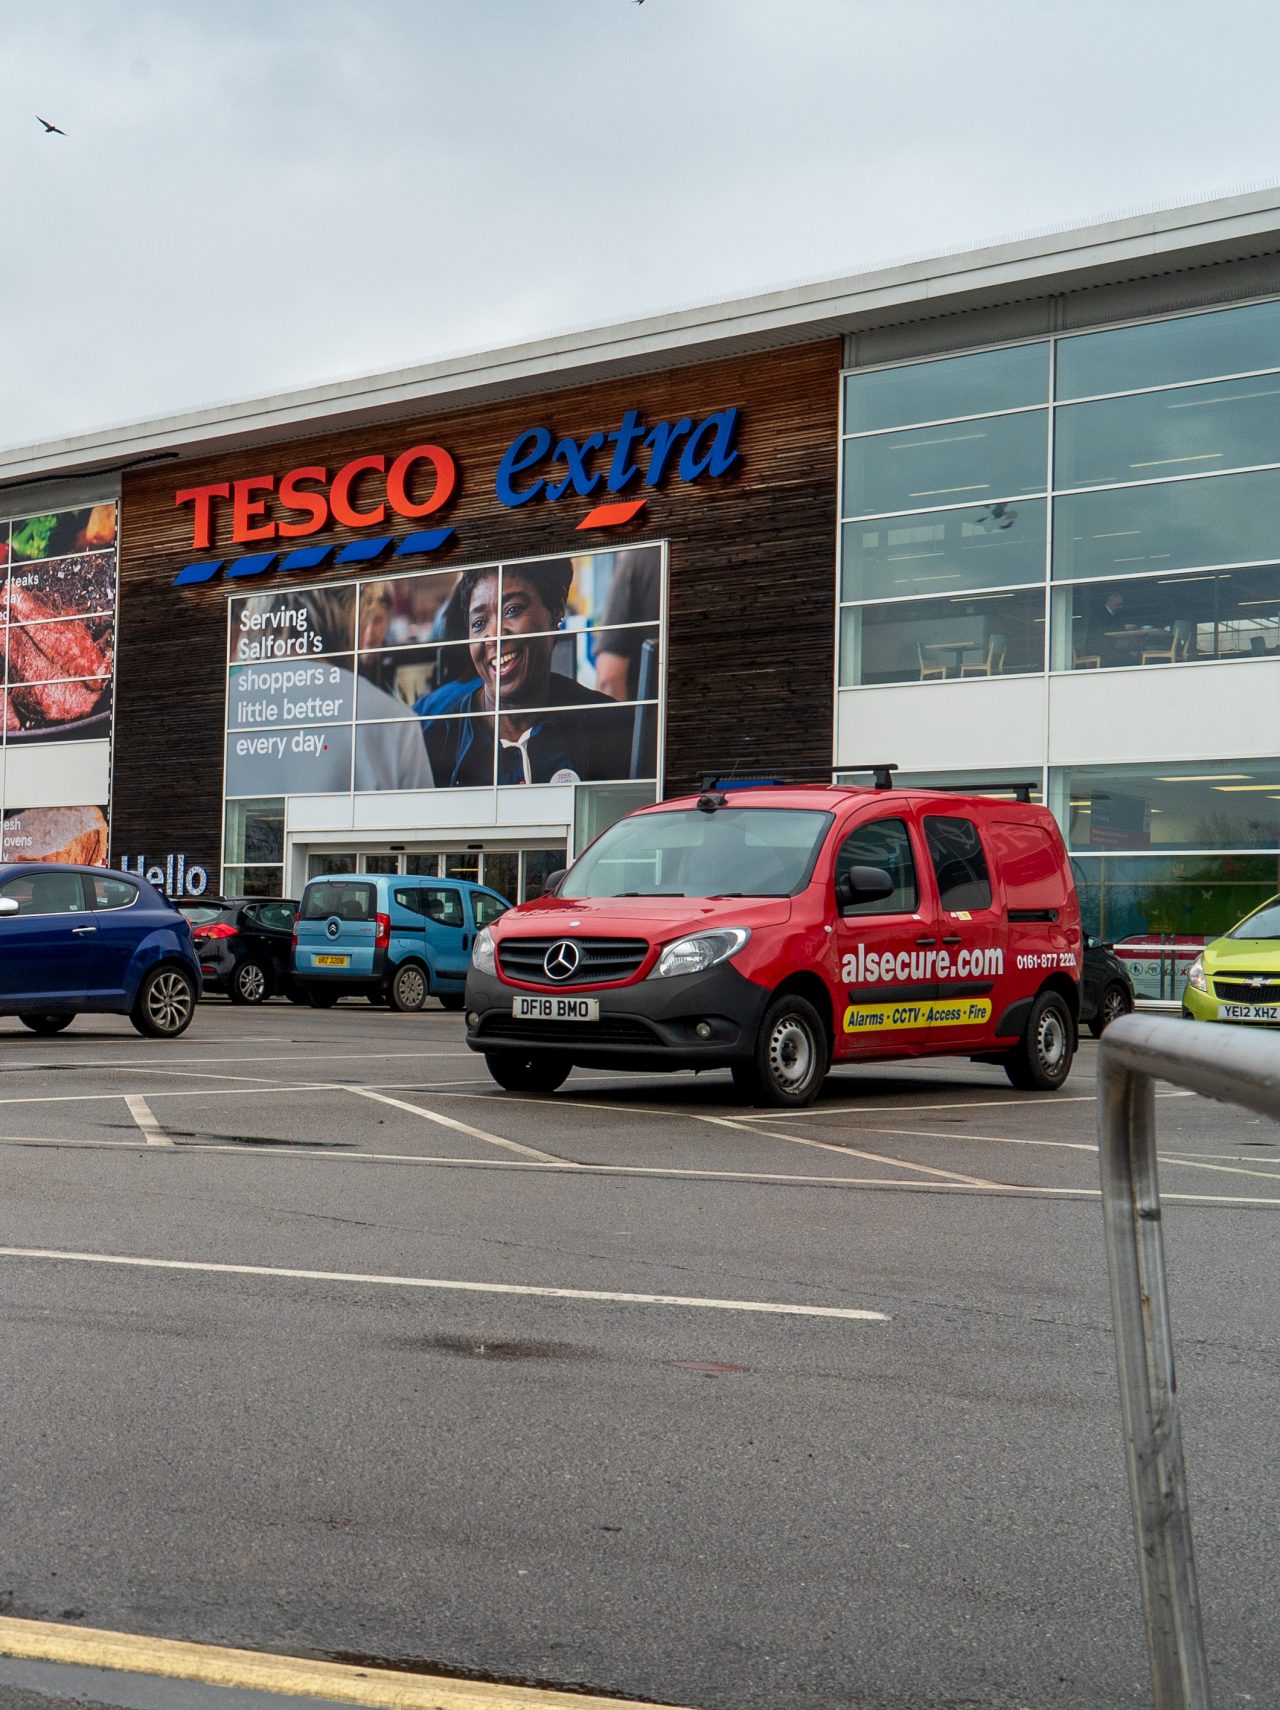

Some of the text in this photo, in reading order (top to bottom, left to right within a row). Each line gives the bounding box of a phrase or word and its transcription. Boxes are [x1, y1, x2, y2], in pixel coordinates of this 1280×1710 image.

[175, 407, 738, 549] TESCO extra
[5, 573, 39, 589] steaks
[240, 606, 308, 632] Serving
[240, 632, 322, 660] Salford's
[238, 668, 340, 694] shoppers a
[238, 698, 344, 723] little better
[236, 736, 287, 759] every
[4, 835, 32, 846] ovens
[121, 854, 207, 896] Hello
[842, 944, 1004, 984] alsecure.com
[521, 999, 588, 1017] DF18 BMO
[848, 1004, 986, 1027] Alarms CCTV Access Fire
[1224, 1006, 1278, 1018] YE12 XHZ
